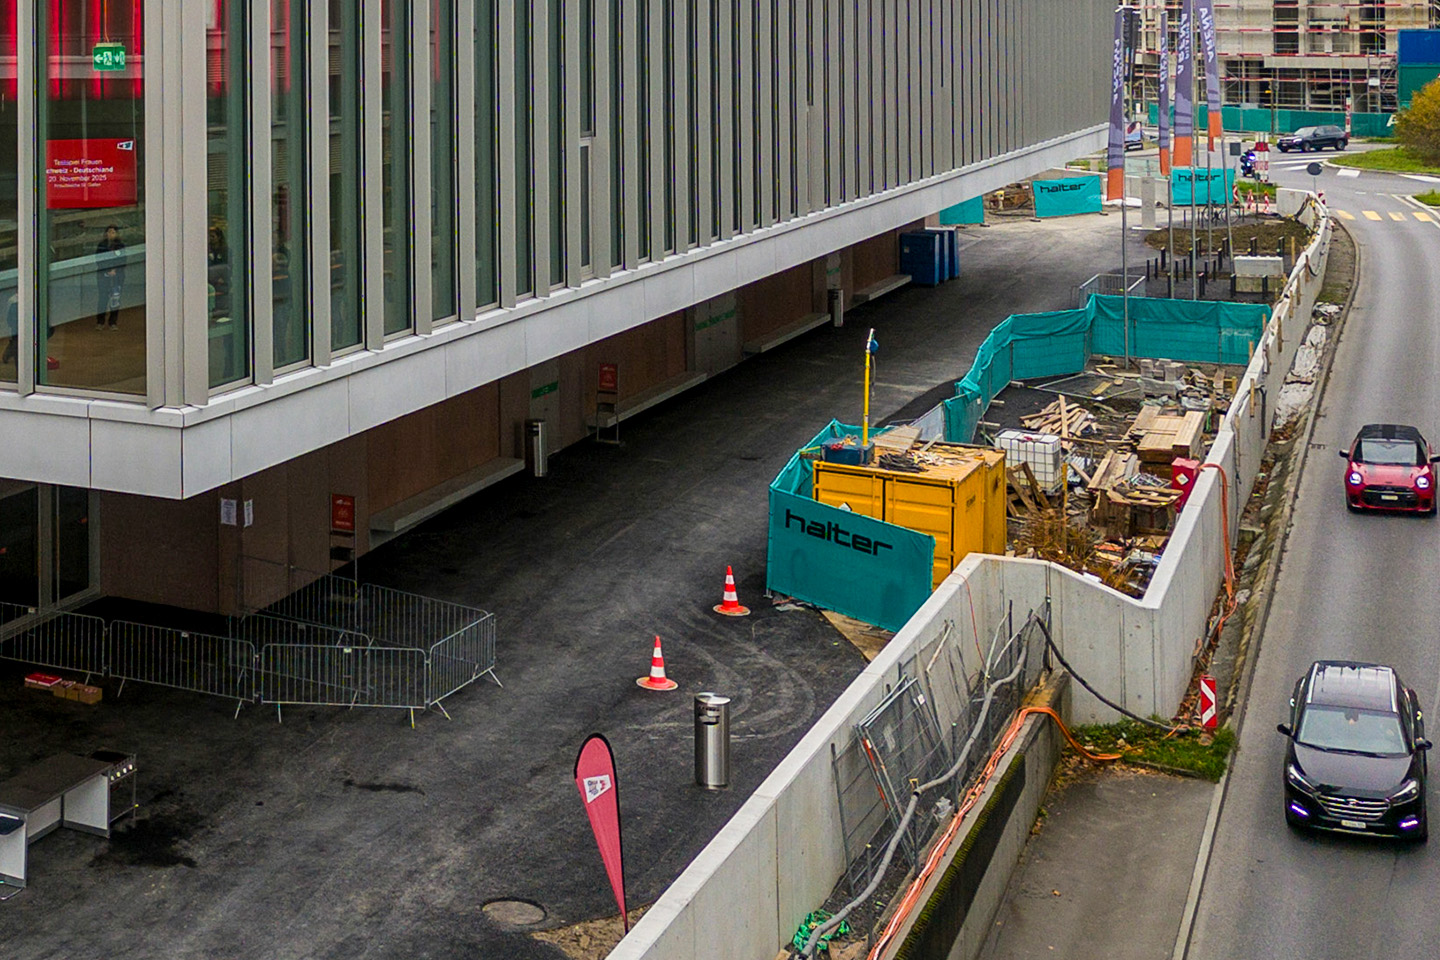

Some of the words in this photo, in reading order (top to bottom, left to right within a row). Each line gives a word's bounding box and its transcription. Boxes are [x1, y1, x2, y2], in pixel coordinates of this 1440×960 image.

[73, 166, 114, 174] Deutschland
[1039, 182, 1086, 194] halter
[784, 508, 893, 556] halter
